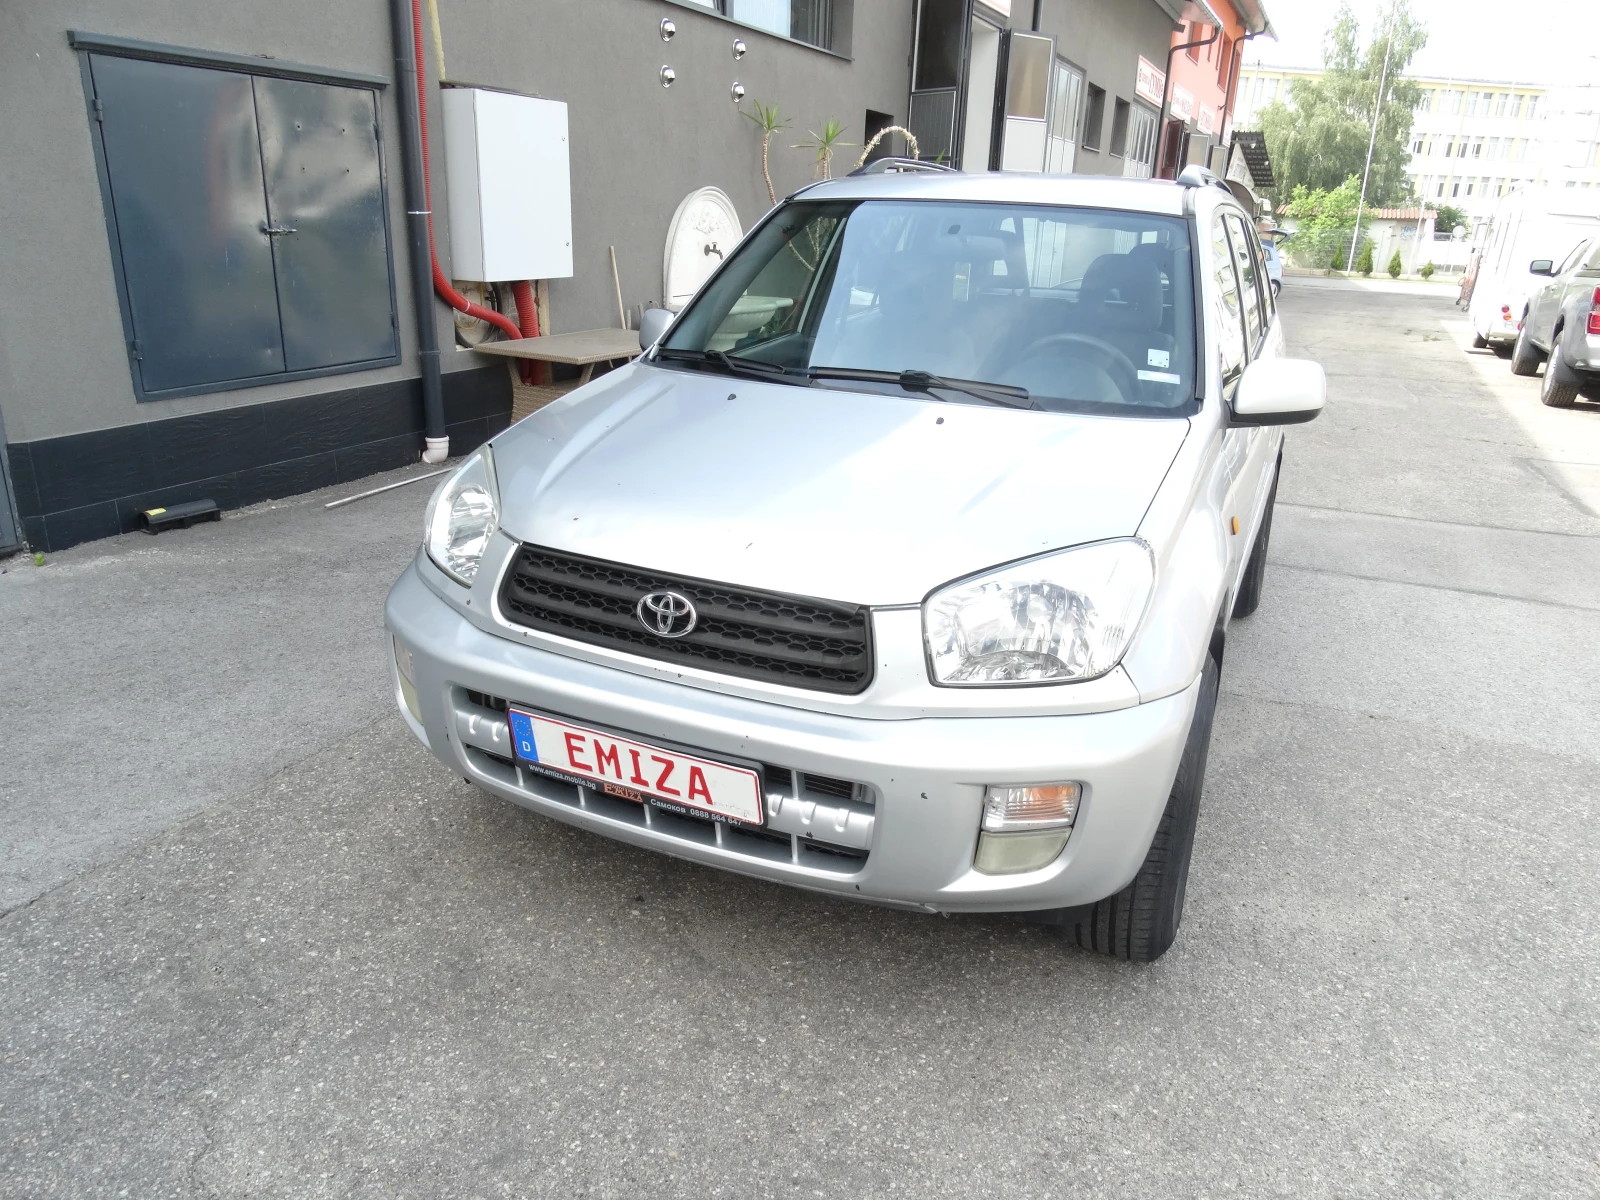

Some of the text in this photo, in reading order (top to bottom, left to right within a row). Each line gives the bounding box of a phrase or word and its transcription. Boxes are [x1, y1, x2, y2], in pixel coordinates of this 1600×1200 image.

[522, 741, 531, 752] D
[528, 764, 597, 790] www.emiza.mobile.bg
[564, 731, 714, 805] EMIZA
[603, 782, 644, 803] EMIZA
[650, 798, 686, 814] Самоков
[690, 808, 710, 819] 0888
[711, 813, 726, 823] 564
